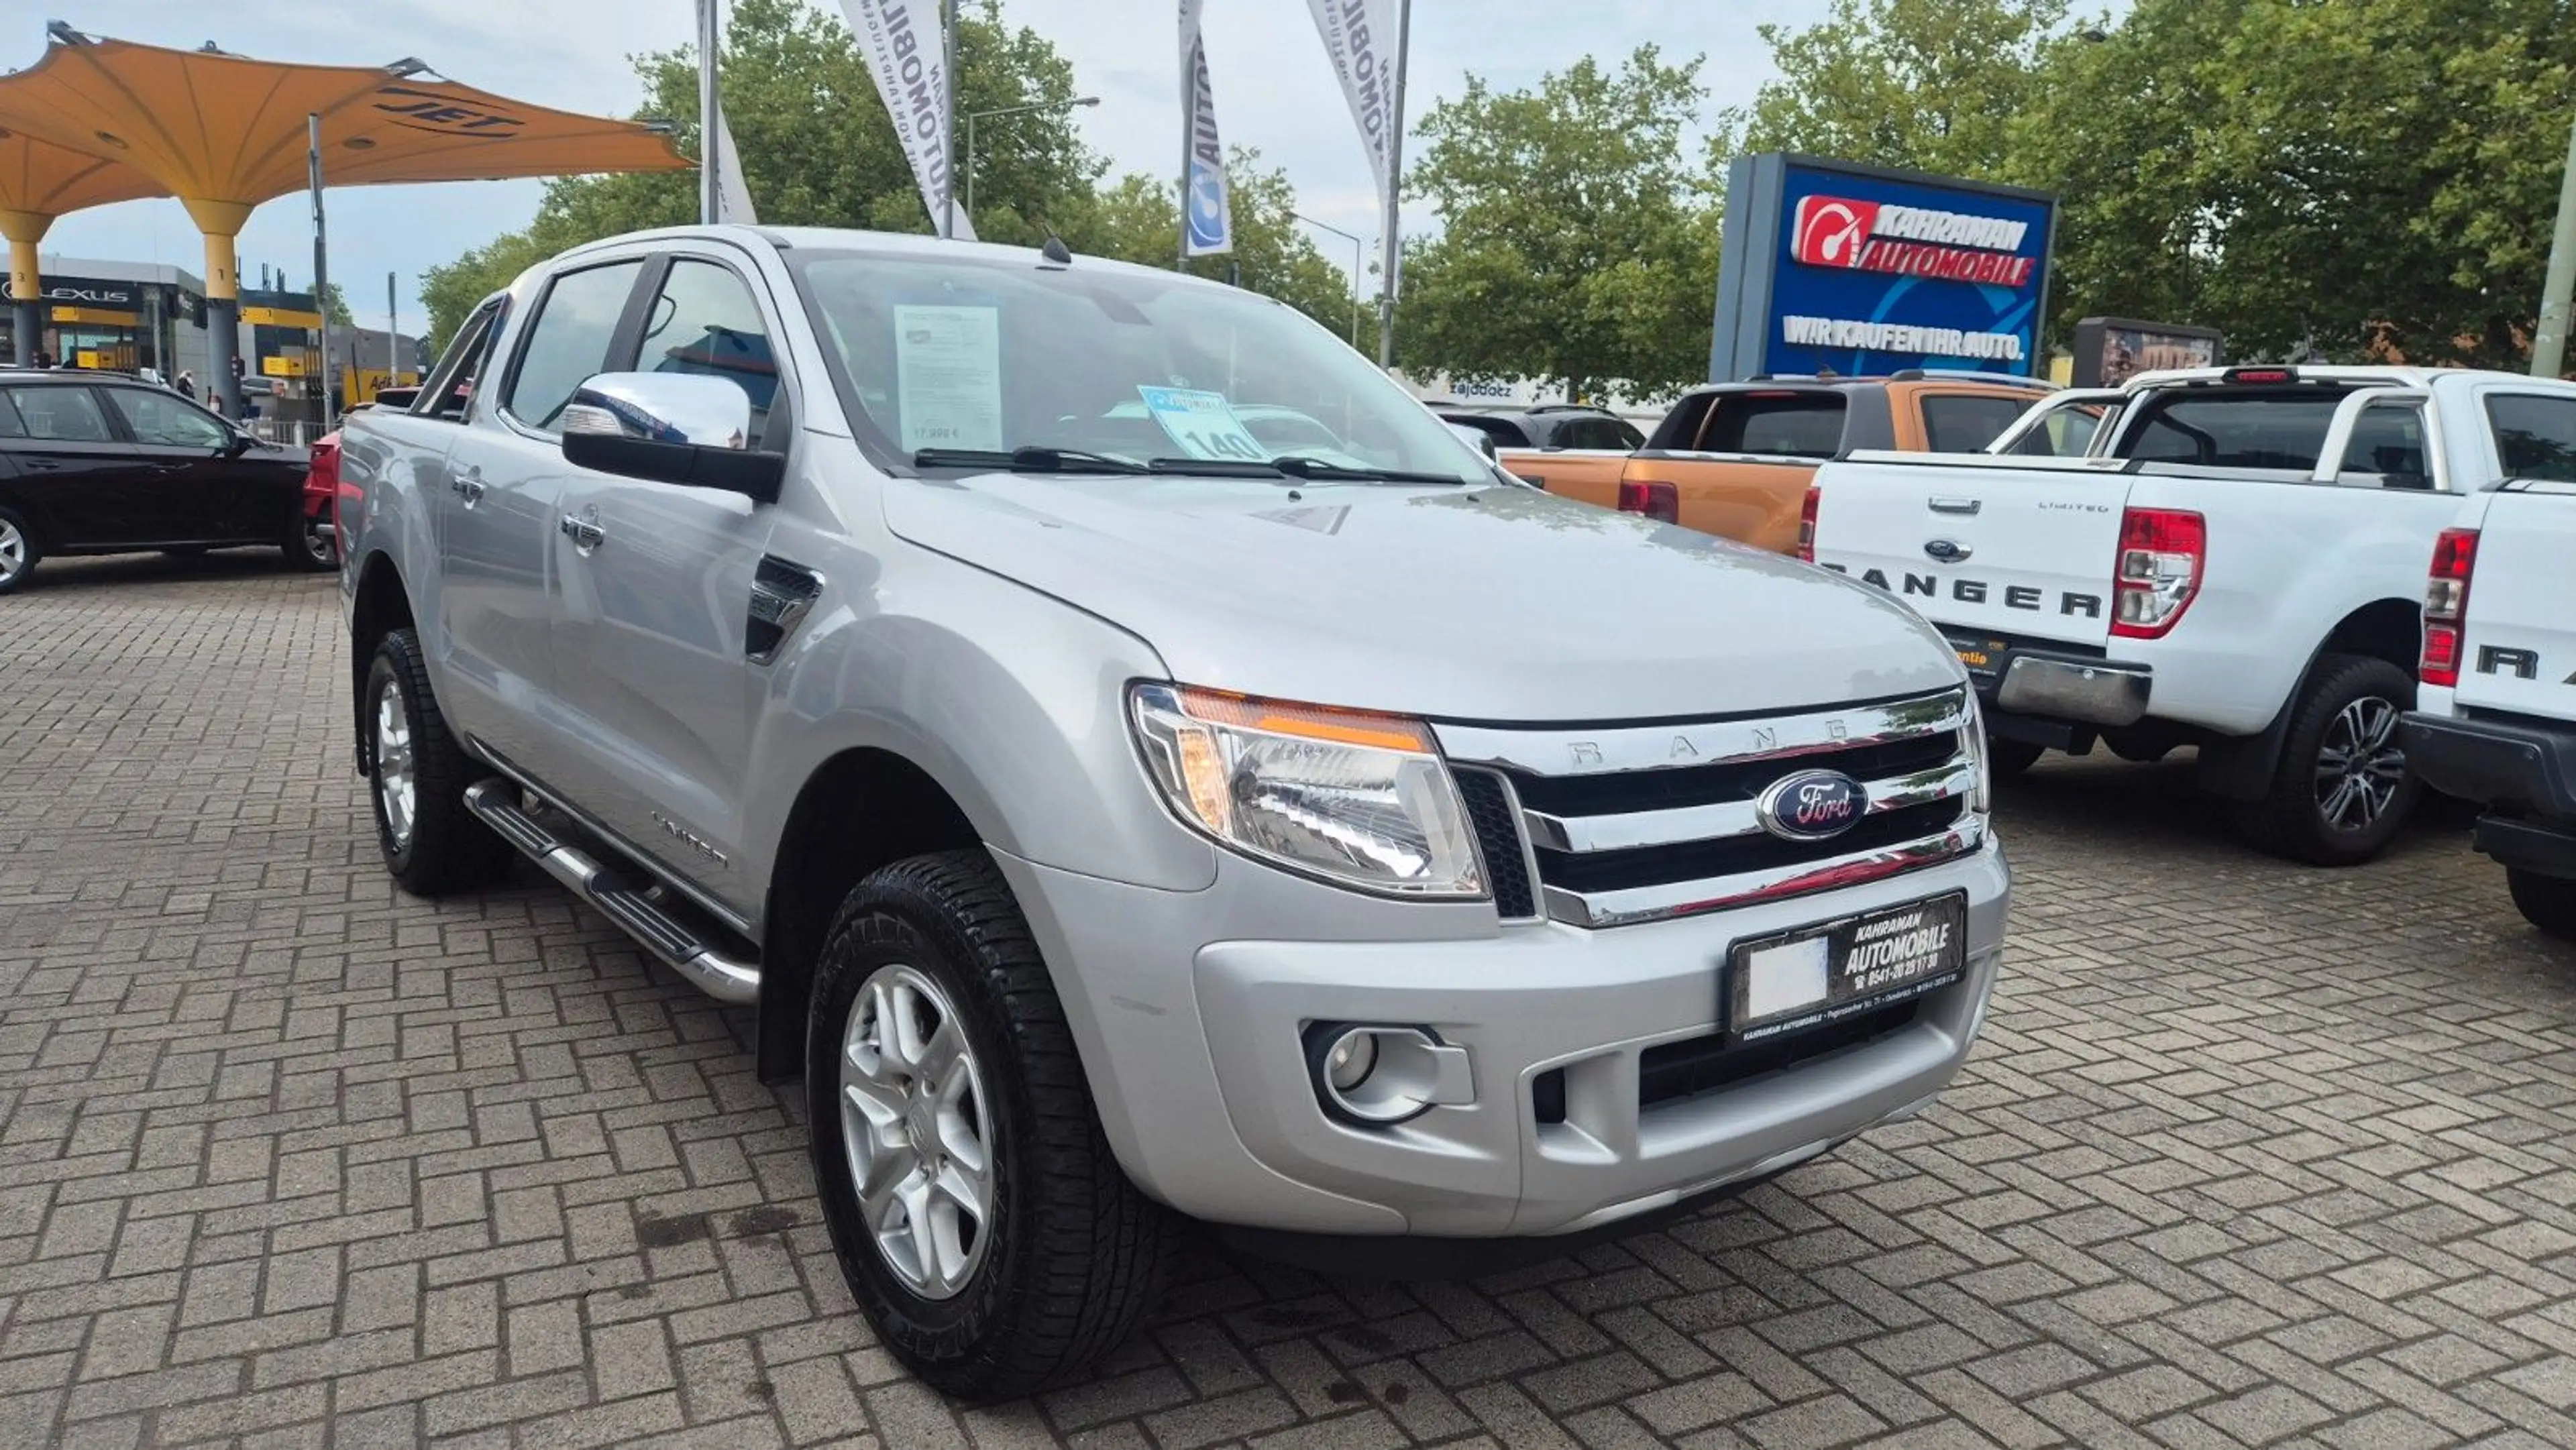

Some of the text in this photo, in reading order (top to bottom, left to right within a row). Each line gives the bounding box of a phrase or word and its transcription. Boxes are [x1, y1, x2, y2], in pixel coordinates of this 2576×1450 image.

[373, 102, 525, 127] JET
[1195, 51, 1220, 166] AUTO
[1871, 204, 2029, 251] KAHRAMAN
[1857, 239, 2037, 287] AUTOMOBILE
[1783, 316, 2025, 361] WIR KAUFEN IHR AUTO.
[1185, 433, 1263, 459] 140
[1796, 783, 1850, 824] Ford
[1856, 913, 1923, 942] KAHRAMAN
[1845, 924, 1949, 977] AUTOMOBILE
